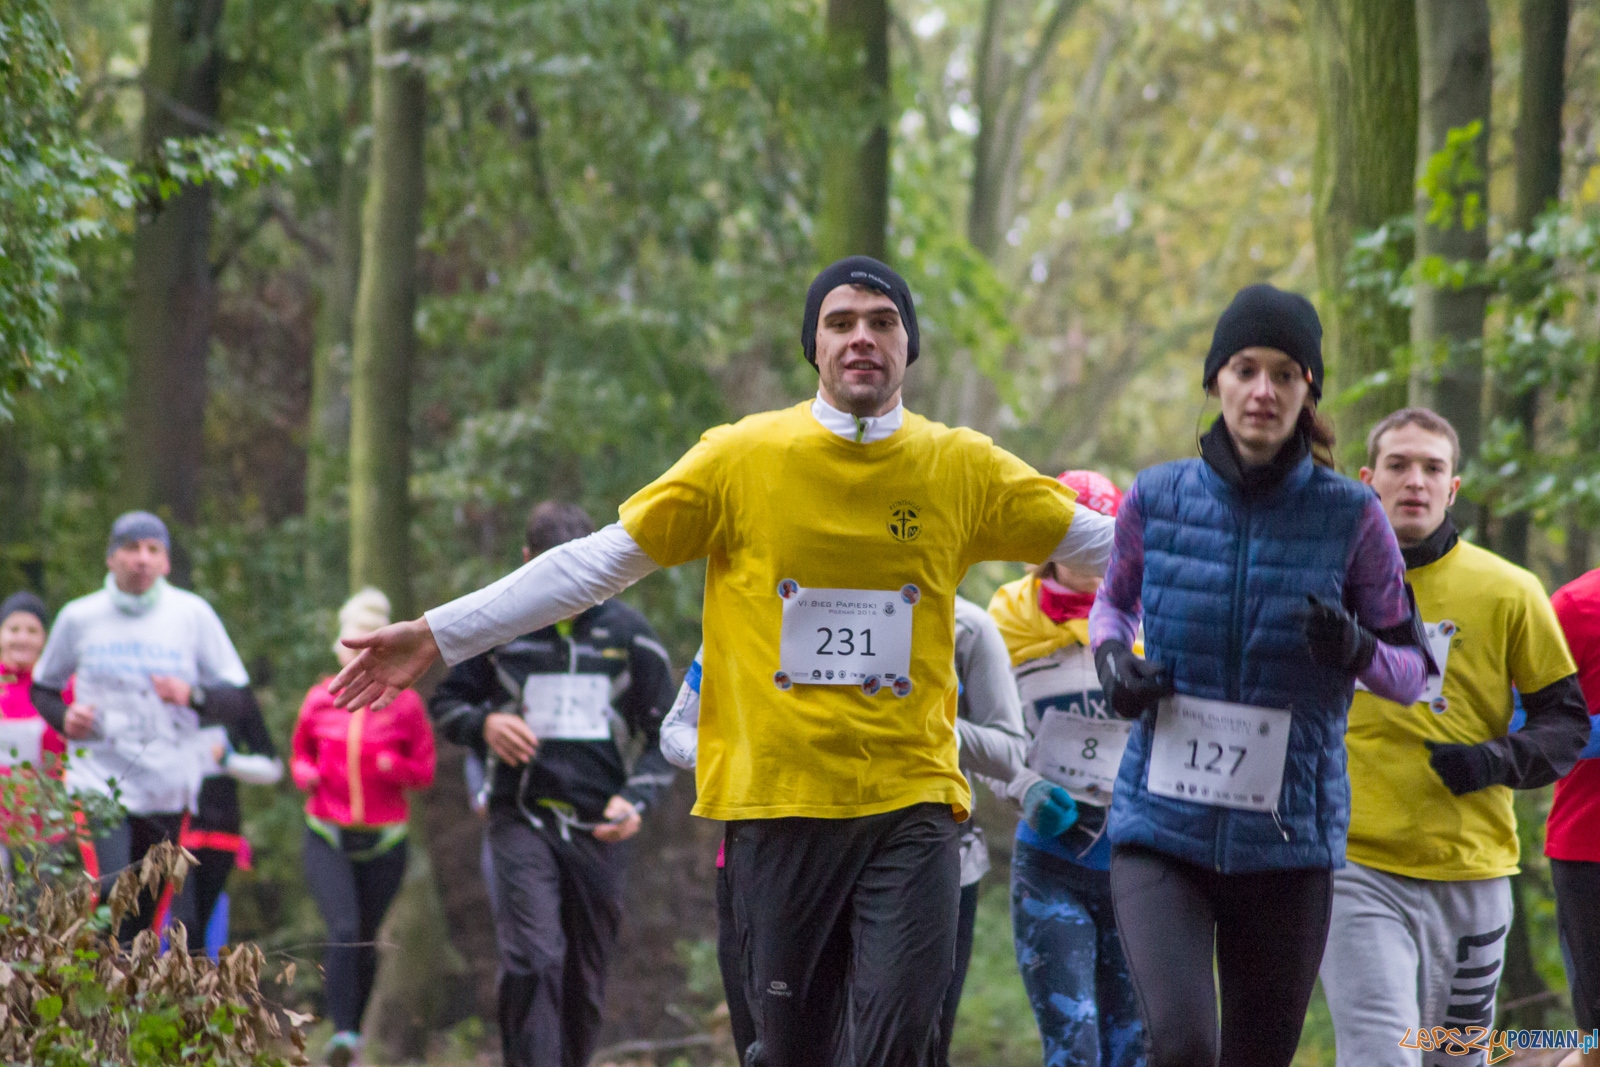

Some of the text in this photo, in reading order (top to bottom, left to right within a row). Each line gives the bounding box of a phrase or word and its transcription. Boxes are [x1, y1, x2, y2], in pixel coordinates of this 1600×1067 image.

[836, 601, 877, 609] PAPIESKI
[816, 627, 876, 656] 231
[1081, 737, 1099, 760] 8
[1184, 738, 1248, 778] 127
